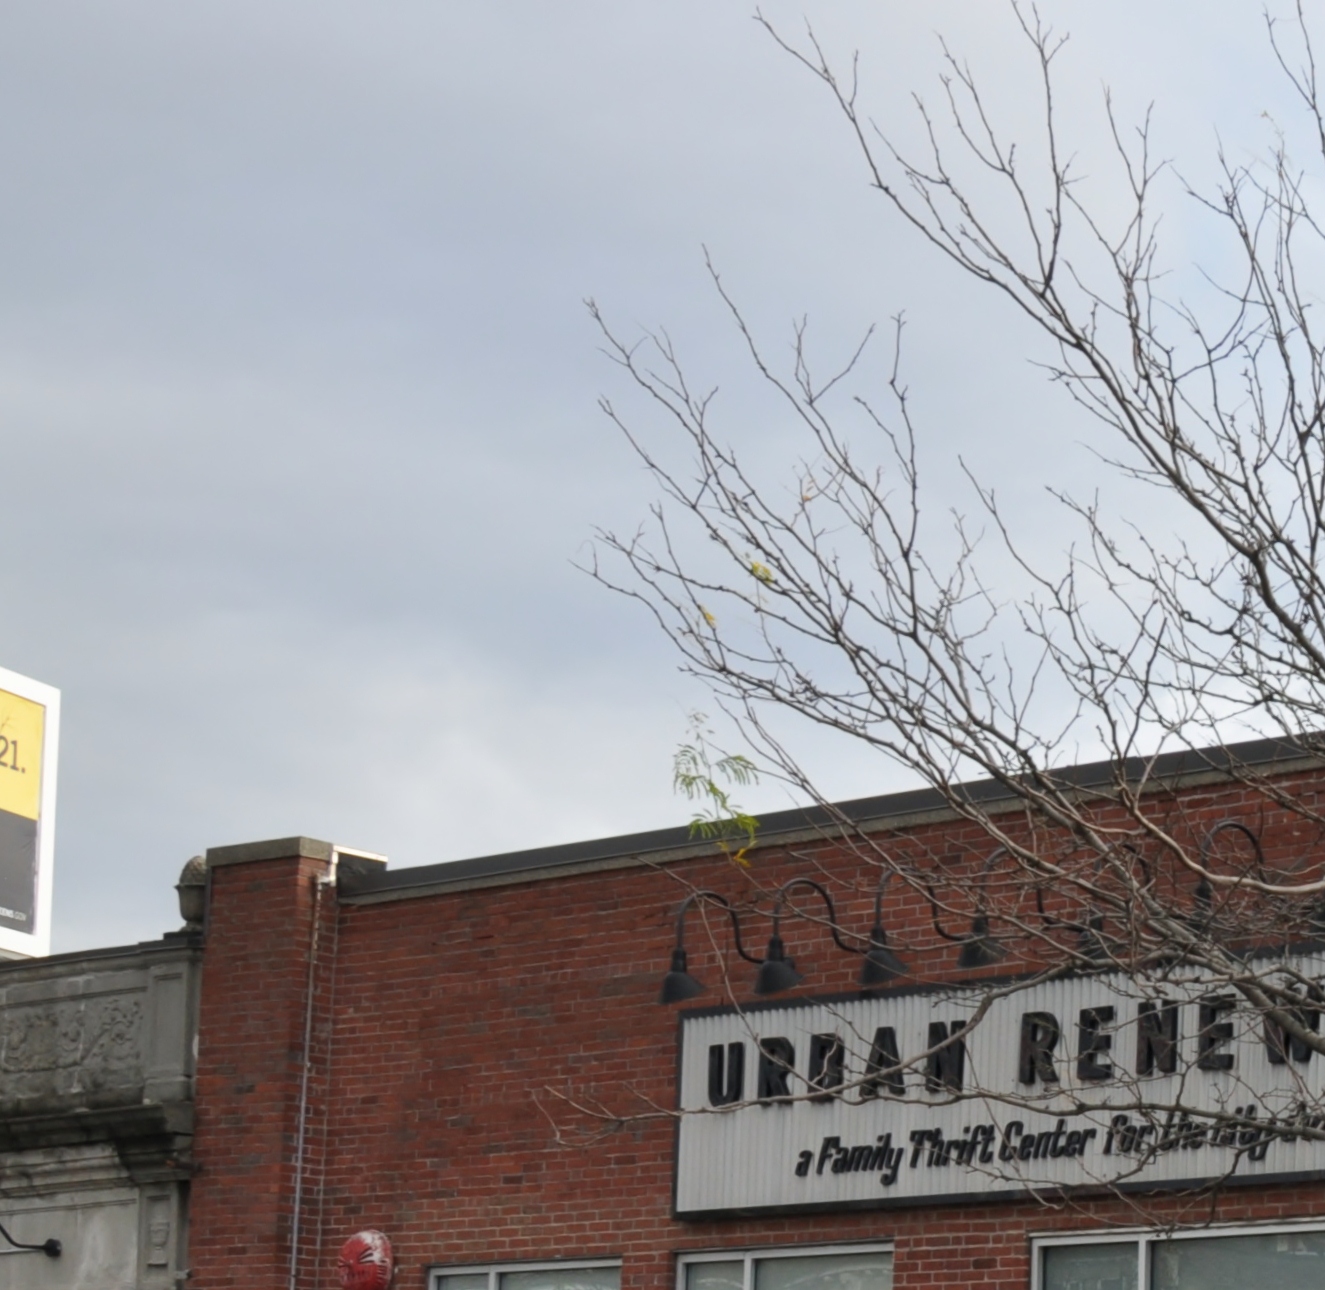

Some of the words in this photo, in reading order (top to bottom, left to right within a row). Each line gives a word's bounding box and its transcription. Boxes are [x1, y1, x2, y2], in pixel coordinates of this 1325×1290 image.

[708, 1020, 966, 1107] URBAN
[795, 1150, 813, 1177] a
[817, 1132, 903, 1186] Family
[910, 1124, 995, 1169] Thrift
[998, 1119, 1096, 1162] Center
[1103, 1114, 1153, 1156] for
